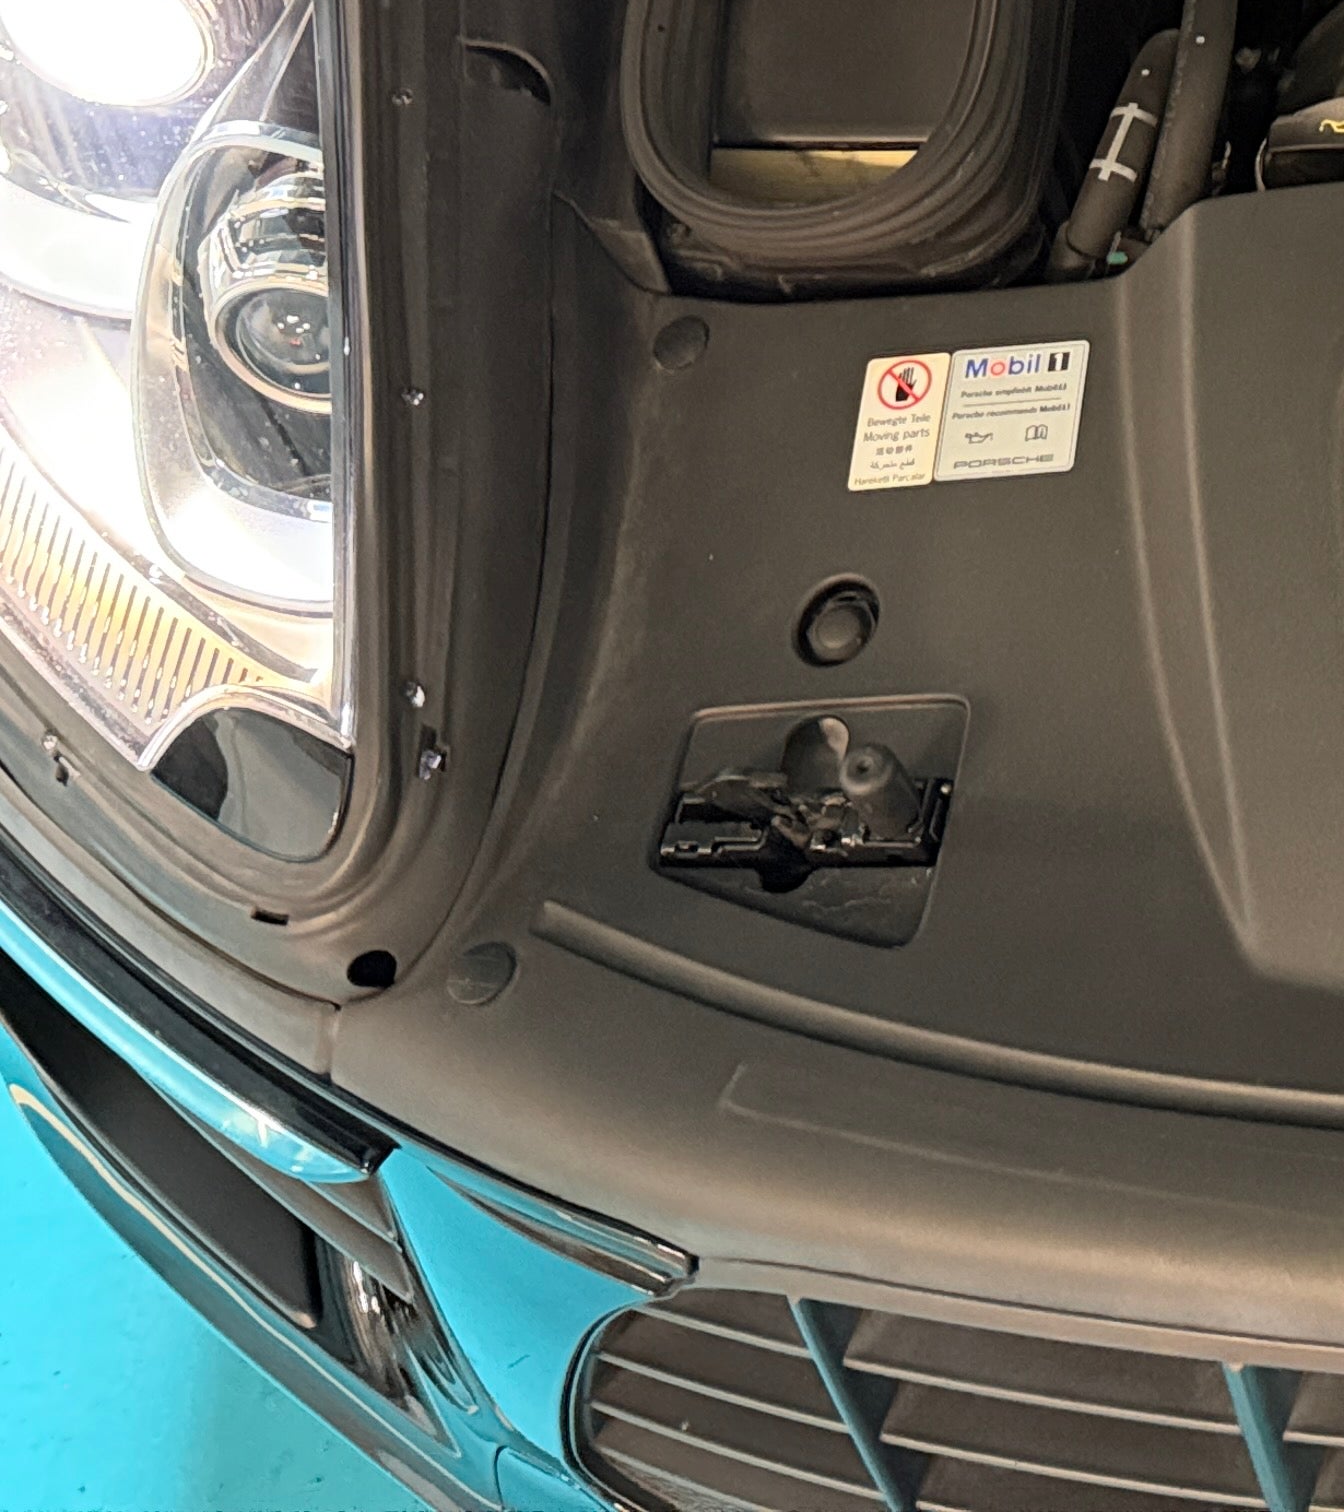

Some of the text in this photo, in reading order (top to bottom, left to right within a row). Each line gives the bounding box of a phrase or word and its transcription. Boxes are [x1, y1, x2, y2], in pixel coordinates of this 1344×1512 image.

[965, 352, 1067, 379] Mobil 1
[863, 428, 930, 442] Moving parts
[953, 454, 1054, 469] PORSCHE
